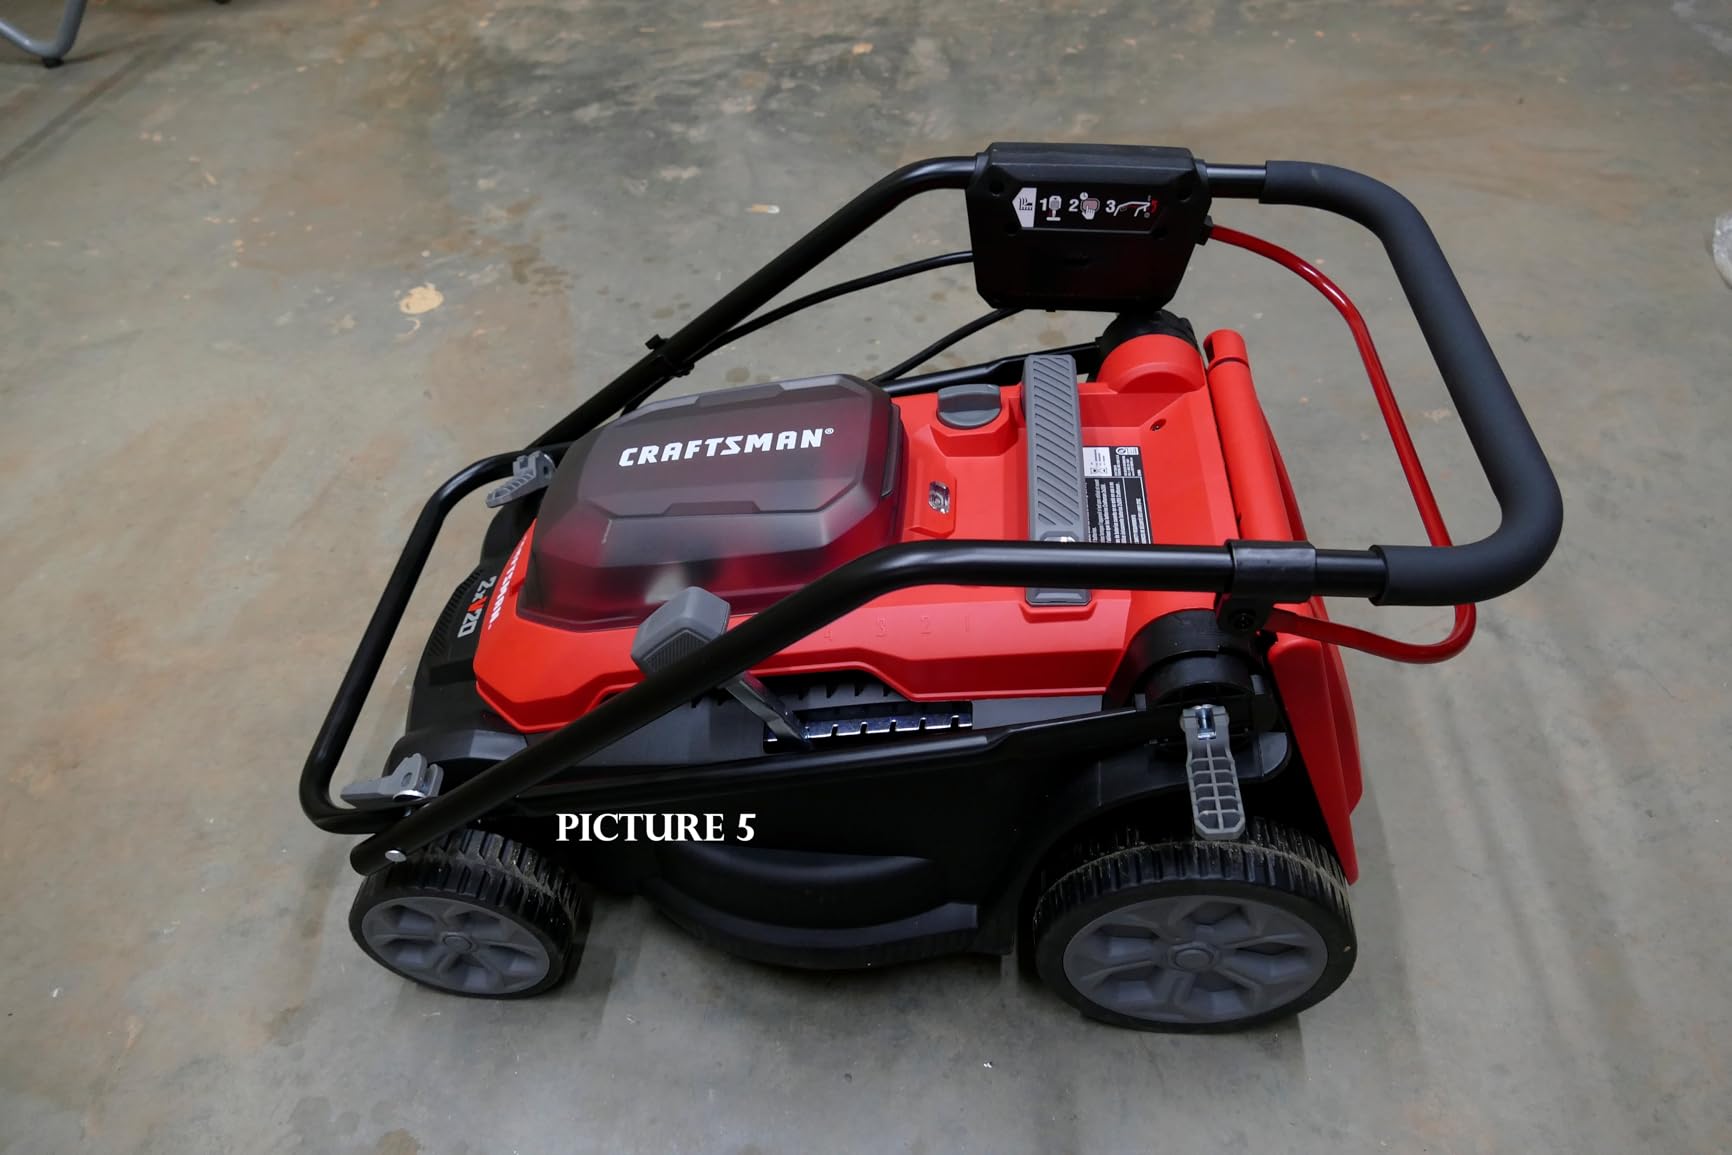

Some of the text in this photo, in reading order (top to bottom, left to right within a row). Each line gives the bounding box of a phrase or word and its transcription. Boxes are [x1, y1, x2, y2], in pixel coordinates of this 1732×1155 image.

[1039, 198, 1116, 213] 1 2 3
